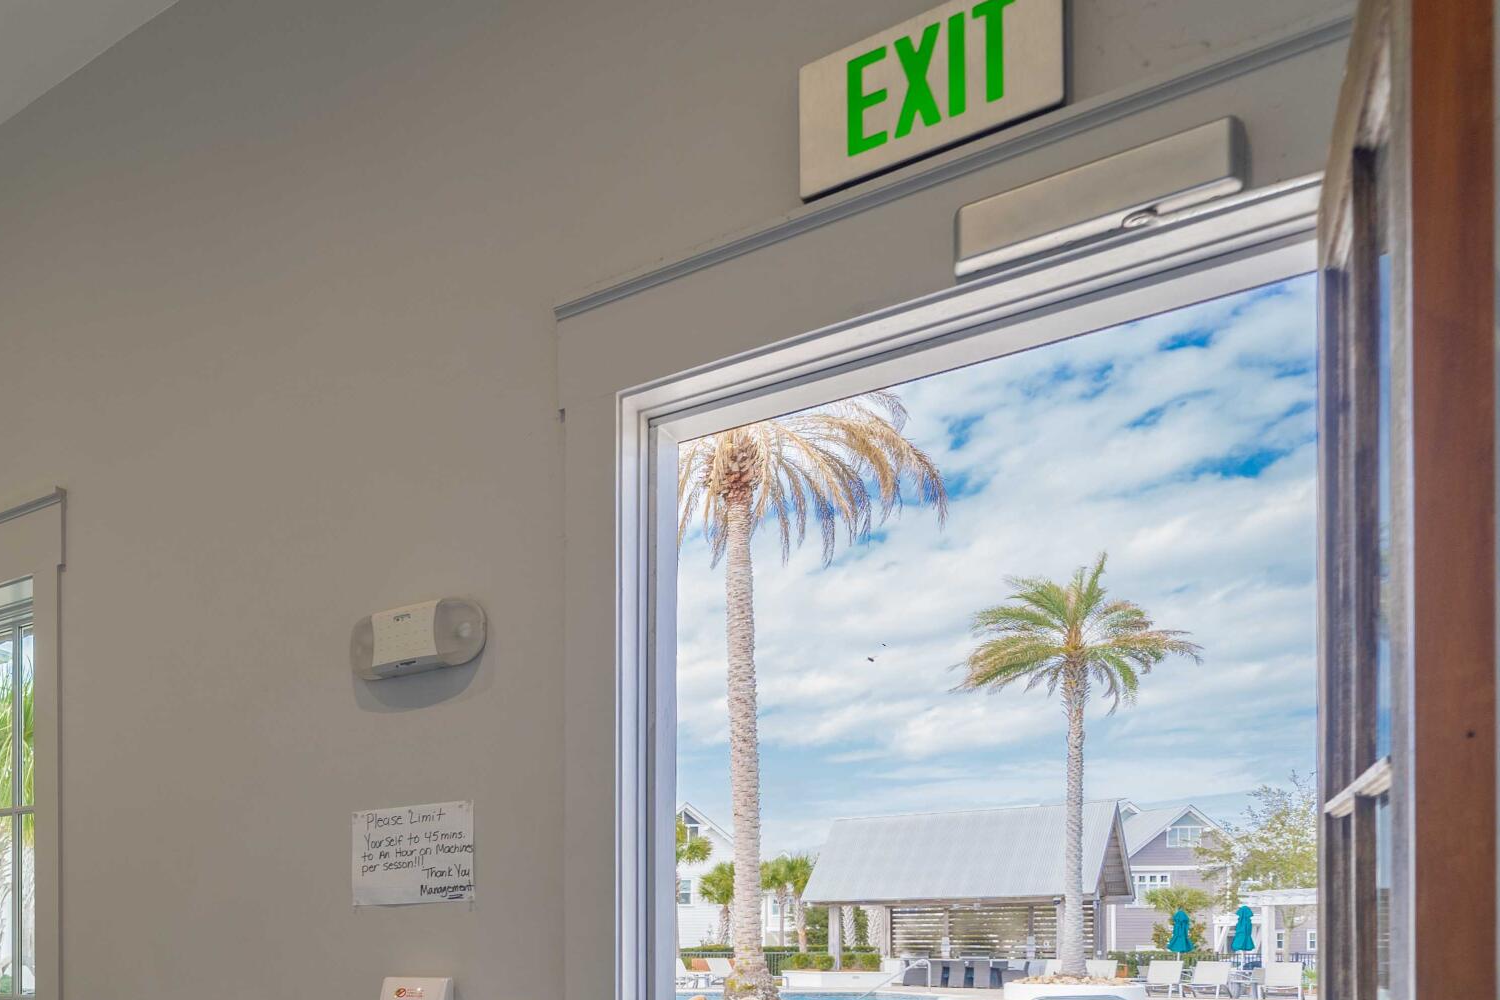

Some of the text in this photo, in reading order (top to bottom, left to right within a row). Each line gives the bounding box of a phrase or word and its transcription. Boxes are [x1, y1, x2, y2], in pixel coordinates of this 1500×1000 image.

[846, 0, 1017, 157] EXIT
[366, 807, 446, 830] Please Limit
[407, 832, 420, 846] to
[424, 830, 439, 843] 45
[361, 843, 474, 862] to An Hour on Machines
[361, 863, 381, 877] per
[421, 863, 470, 880] Thank You
[420, 880, 475, 896] Management
